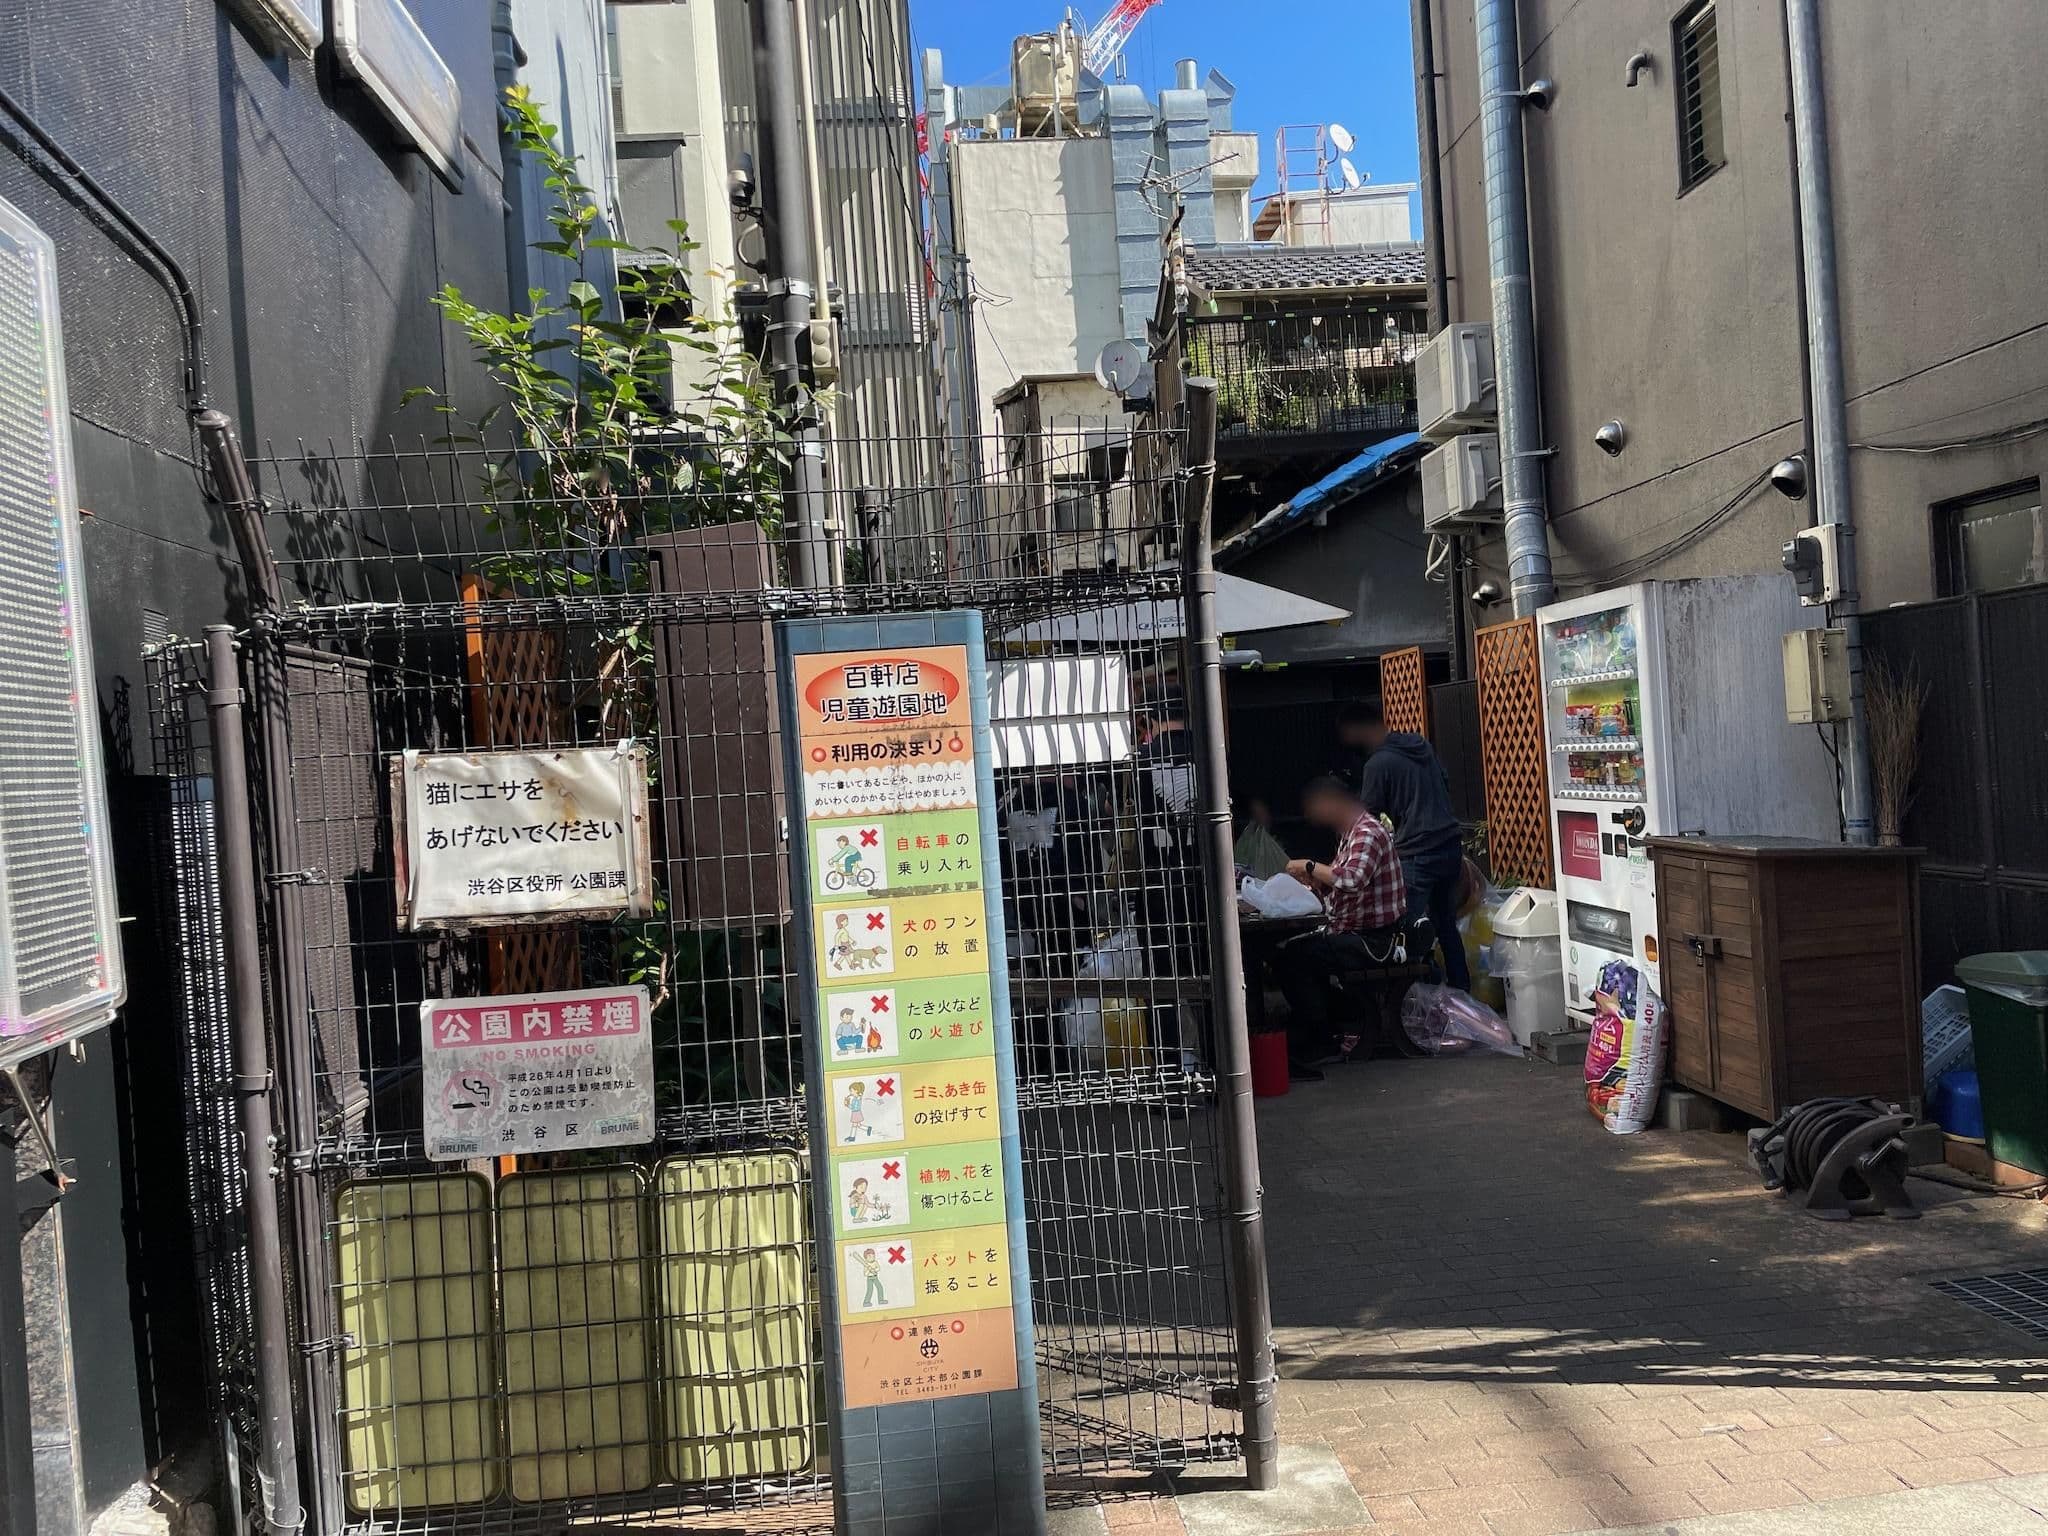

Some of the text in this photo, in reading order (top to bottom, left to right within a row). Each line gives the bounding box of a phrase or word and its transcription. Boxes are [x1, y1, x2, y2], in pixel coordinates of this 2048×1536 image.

[844, 663, 919, 689] 百軒店
[821, 692, 947, 723] 児童遊園地
[831, 739, 943, 763] 利用の決まり
[426, 778, 543, 805] 猫にエサを
[427, 819, 623, 850] あげないでください
[897, 832, 969, 851] 自転車の
[897, 856, 972, 876] 乗り入れ
[468, 870, 627, 896] 渋谷区役所 公園課
[903, 916, 977, 934] 犬のフン
[904, 938, 979, 957] の放置
[907, 996, 981, 1017] たき火など
[438, 1001, 634, 1044] 公園内禁煙
[909, 1020, 983, 1040] の火遊び
[482, 1044, 596, 1063] NO SMOKING
[913, 1080, 987, 1100] ゴミ、あき缶
[914, 1105, 987, 1125] の投げすて
[502, 1123, 578, 1142] 渋谷区
[601, 1121, 639, 1135] BRUME
[439, 1143, 478, 1153] BRUME
[919, 1163, 993, 1184] 植物、花を
[920, 1188, 995, 1210] 傷つけること
[923, 1247, 998, 1268] バットを
[925, 1273, 999, 1295] 振ること
[908, 1324, 948, 1337] 連絡先
